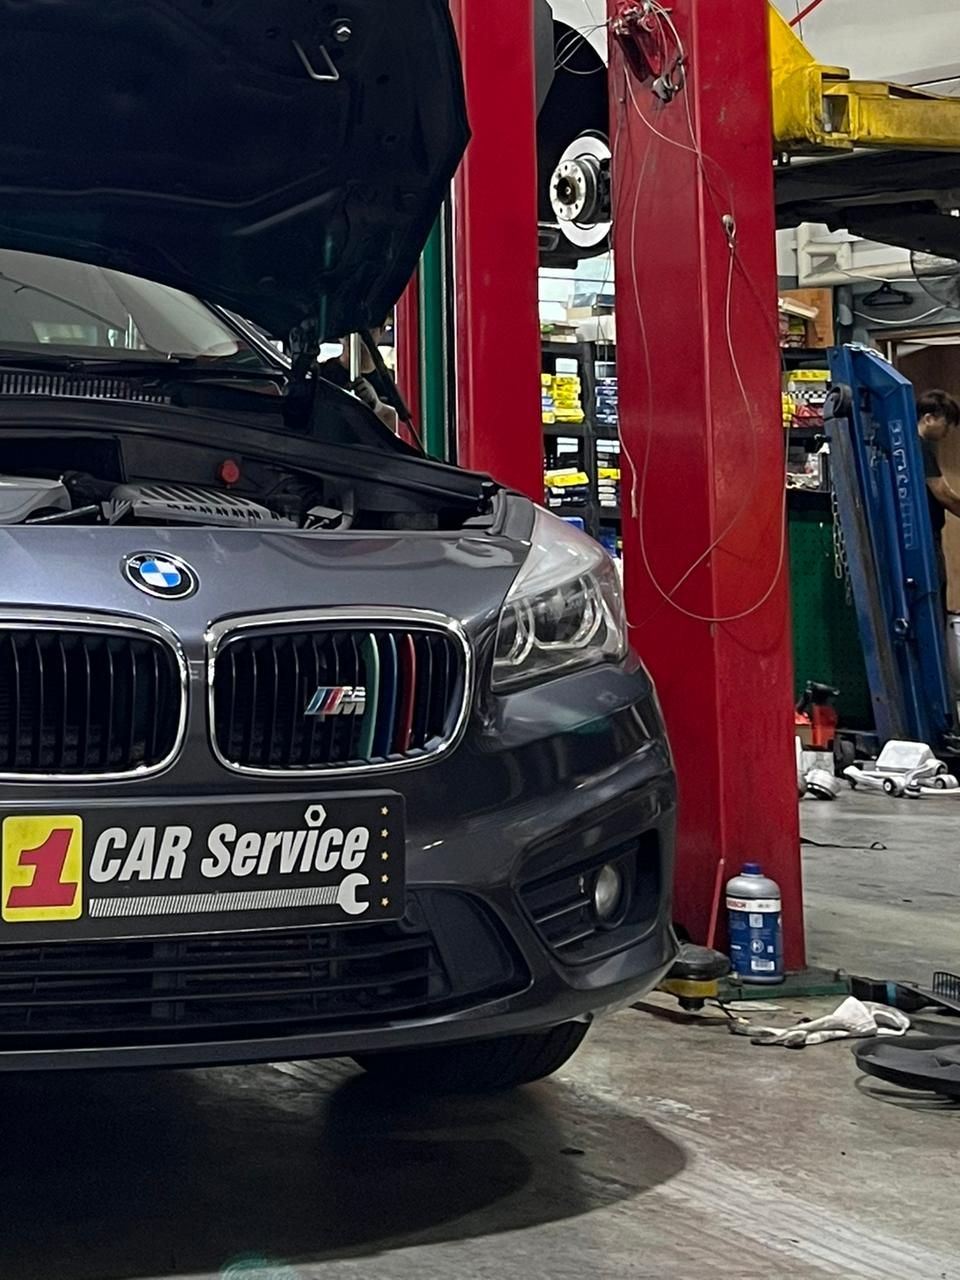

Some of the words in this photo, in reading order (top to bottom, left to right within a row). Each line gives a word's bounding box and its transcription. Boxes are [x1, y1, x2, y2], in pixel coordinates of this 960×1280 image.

[5, 828, 79, 908] 1
[89, 826, 192, 883] CAR
[200, 805, 370, 878] Service
